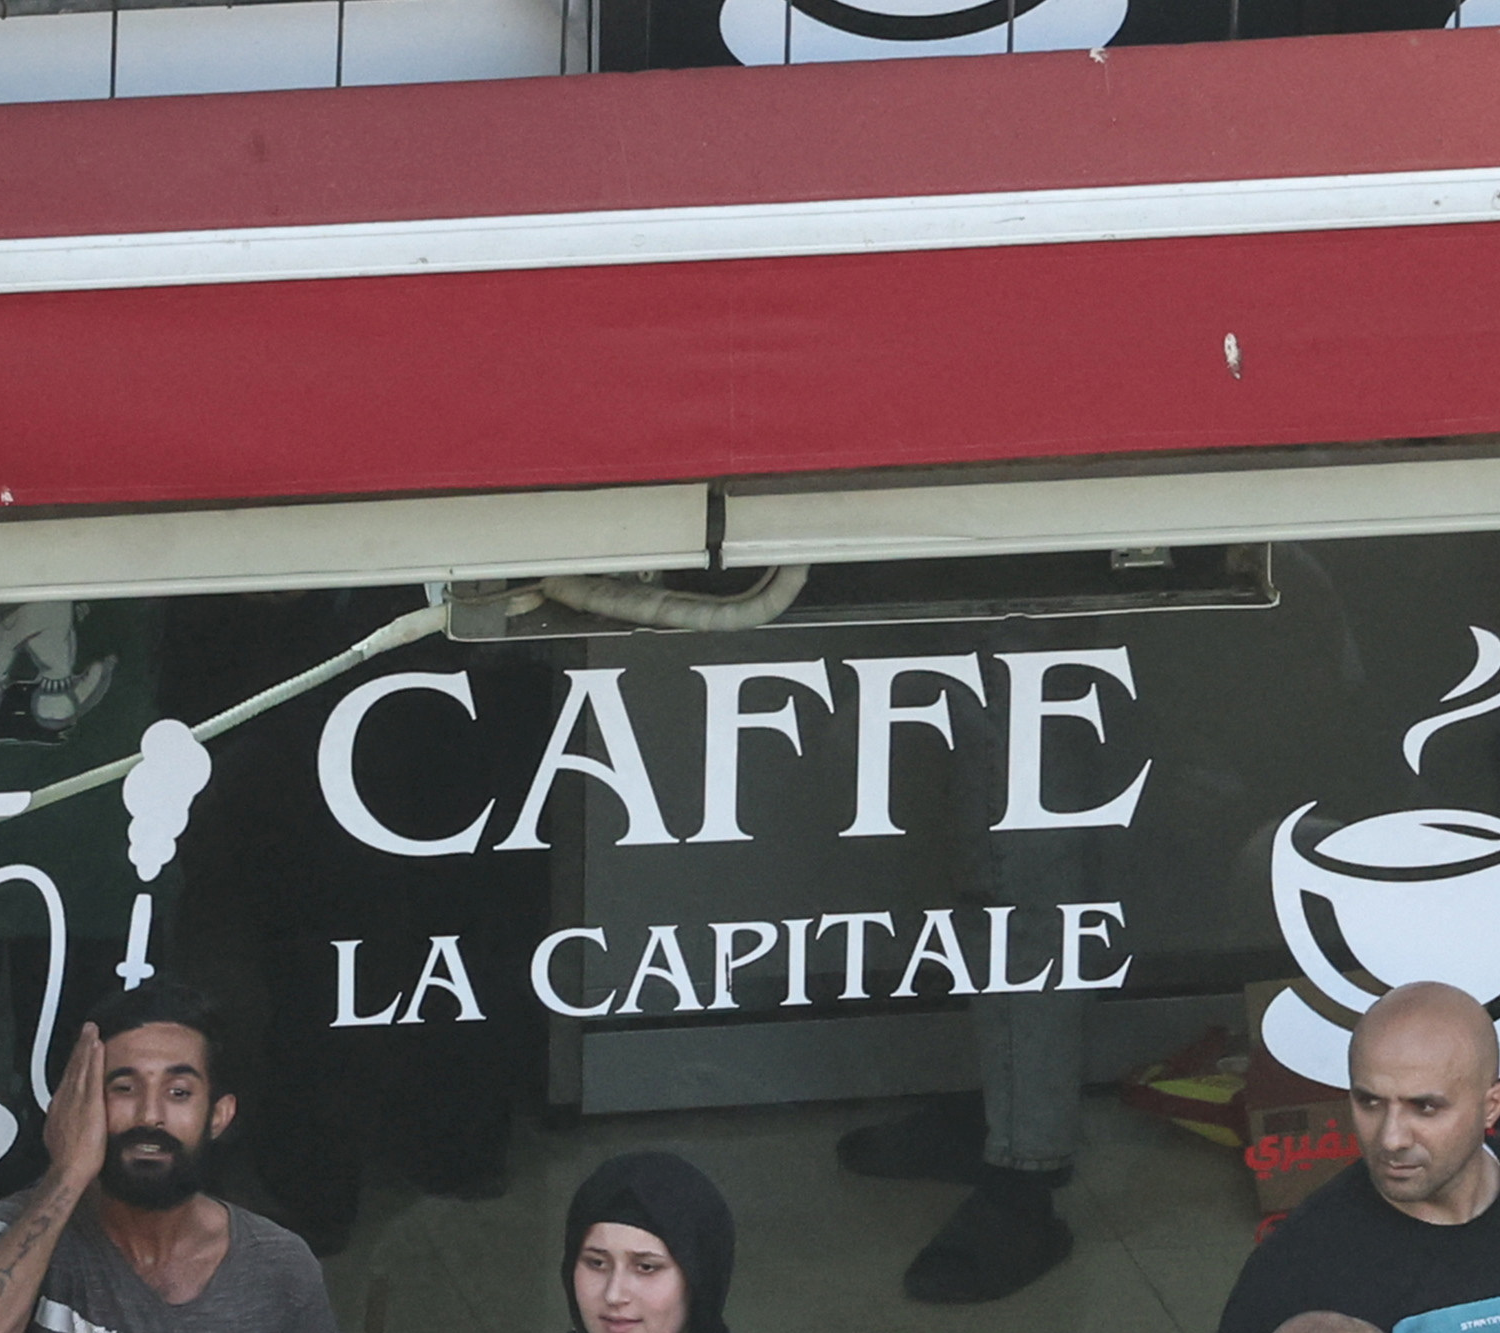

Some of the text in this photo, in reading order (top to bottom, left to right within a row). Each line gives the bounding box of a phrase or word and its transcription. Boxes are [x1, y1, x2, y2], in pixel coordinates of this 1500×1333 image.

[317, 646, 1153, 857] CAFFE
[329, 901, 1134, 1027] LA CAPITALE
